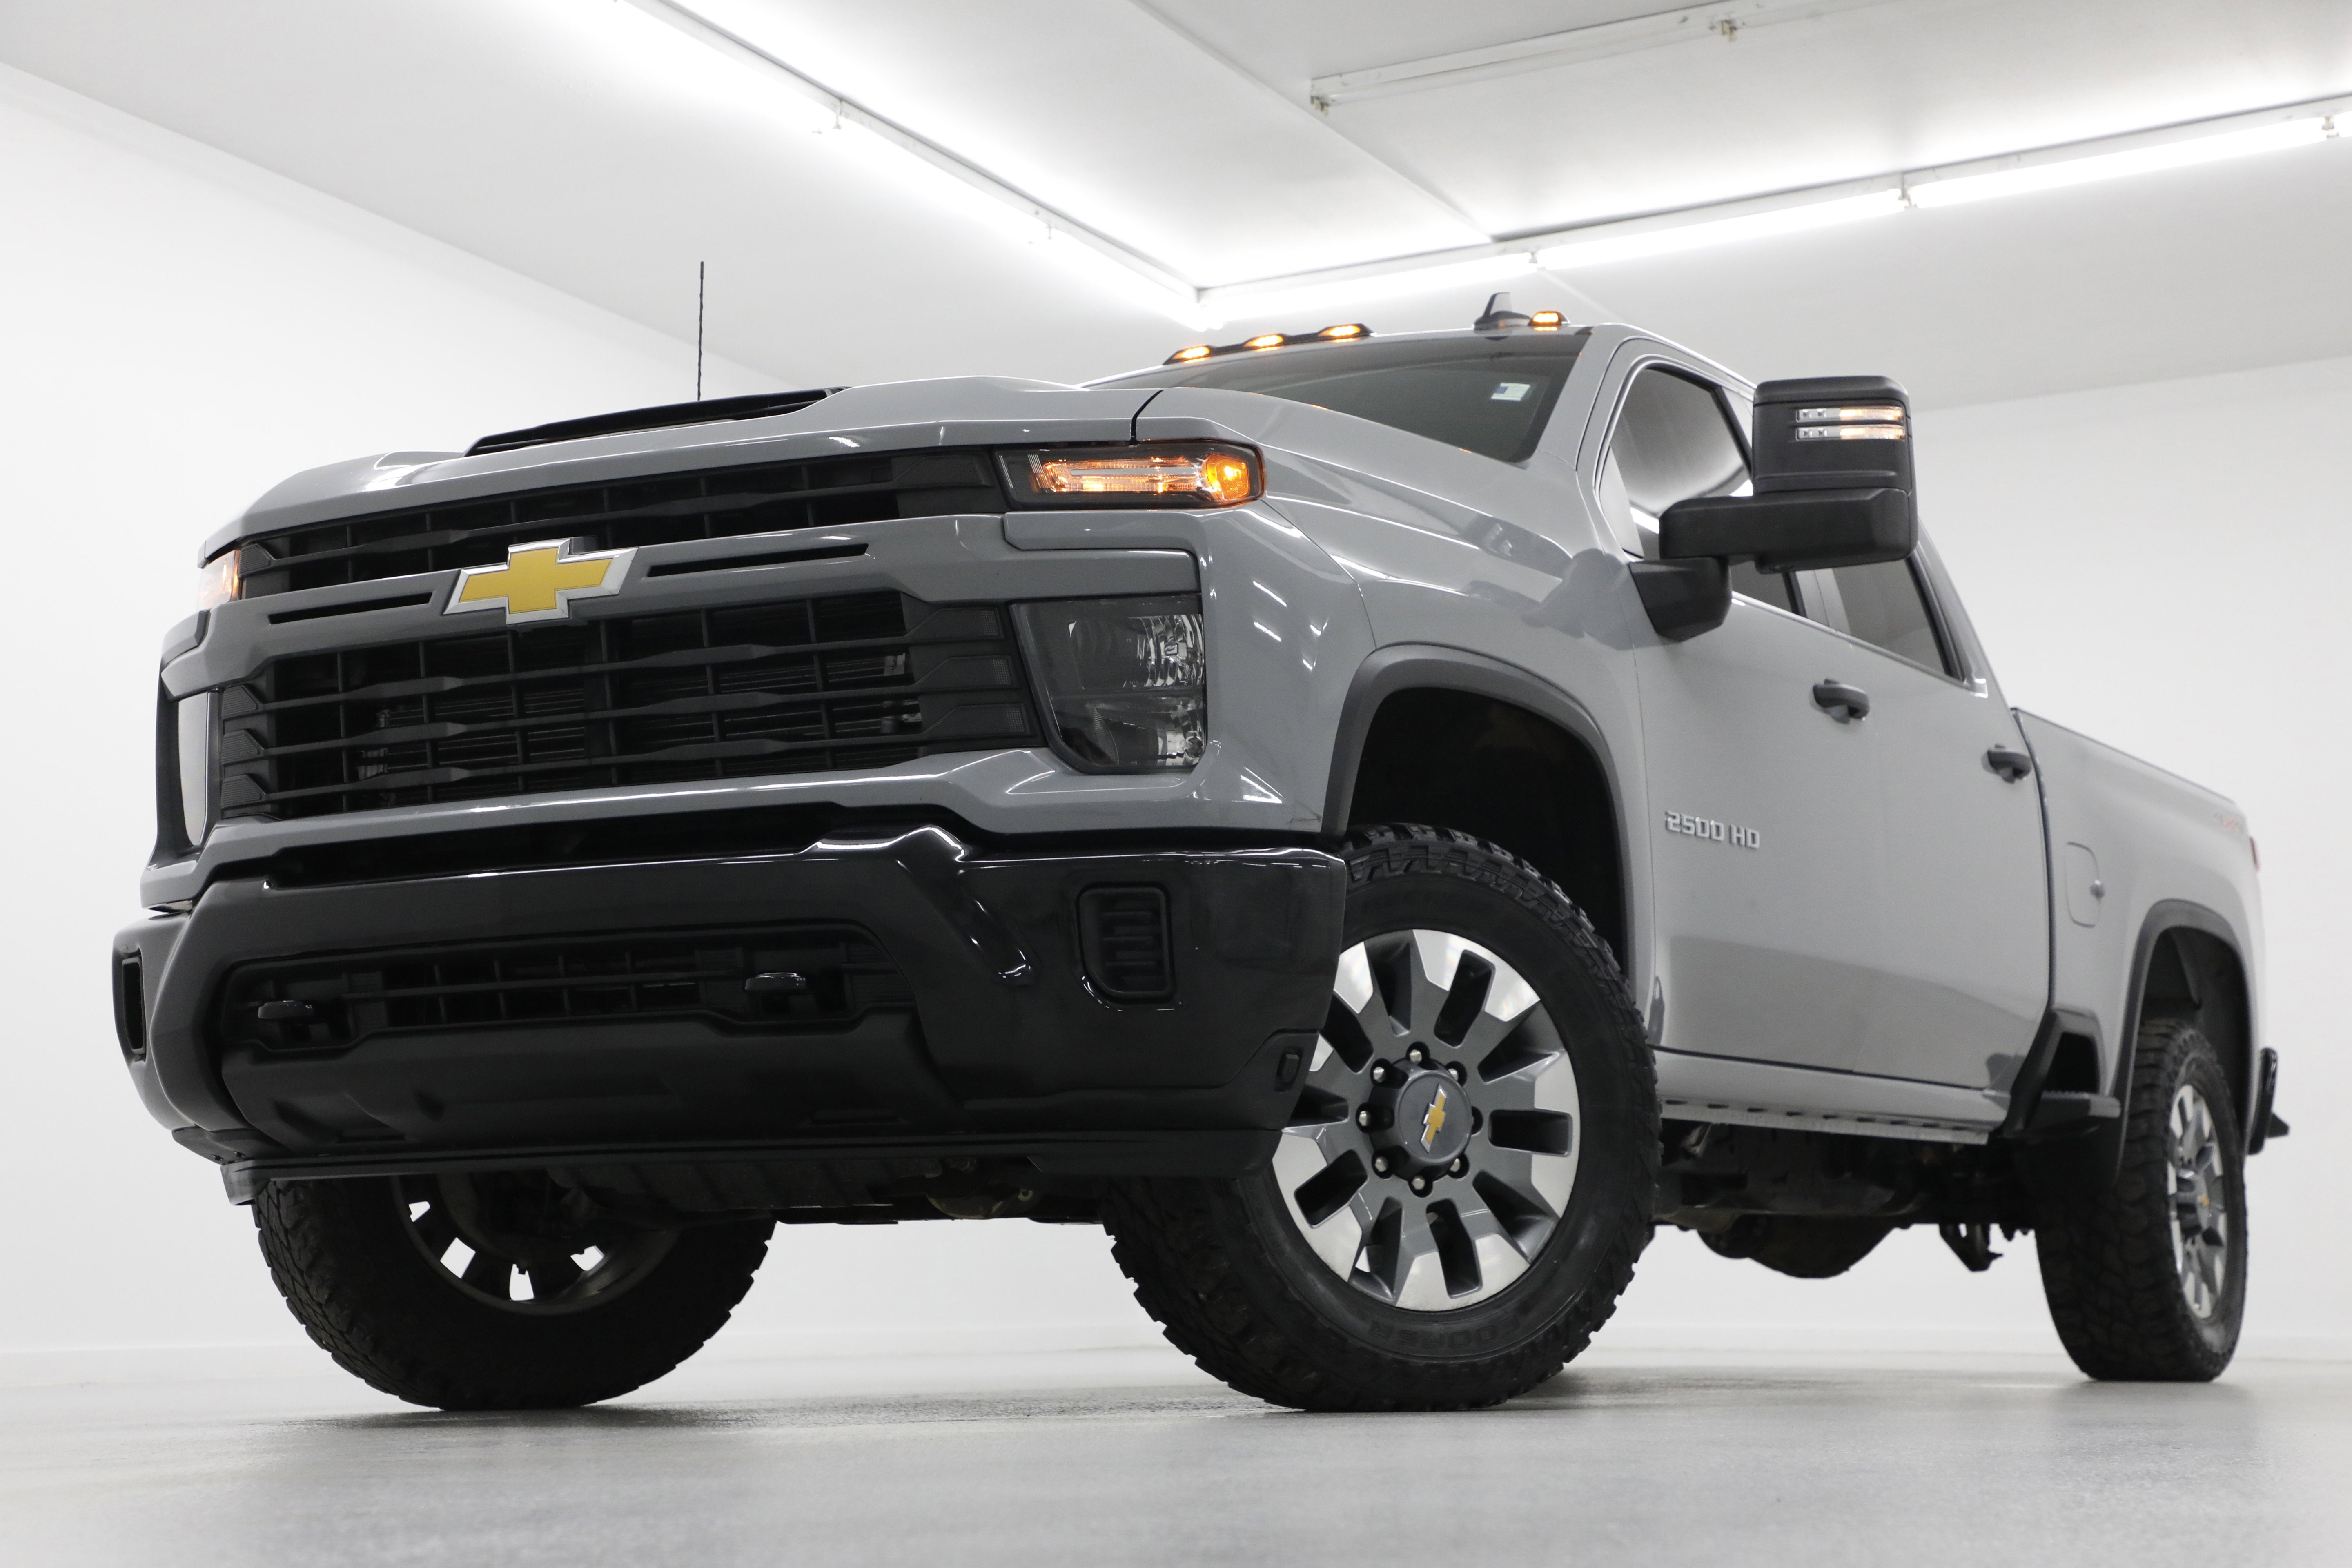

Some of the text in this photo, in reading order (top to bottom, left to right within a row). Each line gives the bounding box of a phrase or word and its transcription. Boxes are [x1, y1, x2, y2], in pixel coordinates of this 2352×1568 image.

[1665, 810, 1760, 849] 2500 HD
[1368, 1314, 1520, 1349] COOPER
